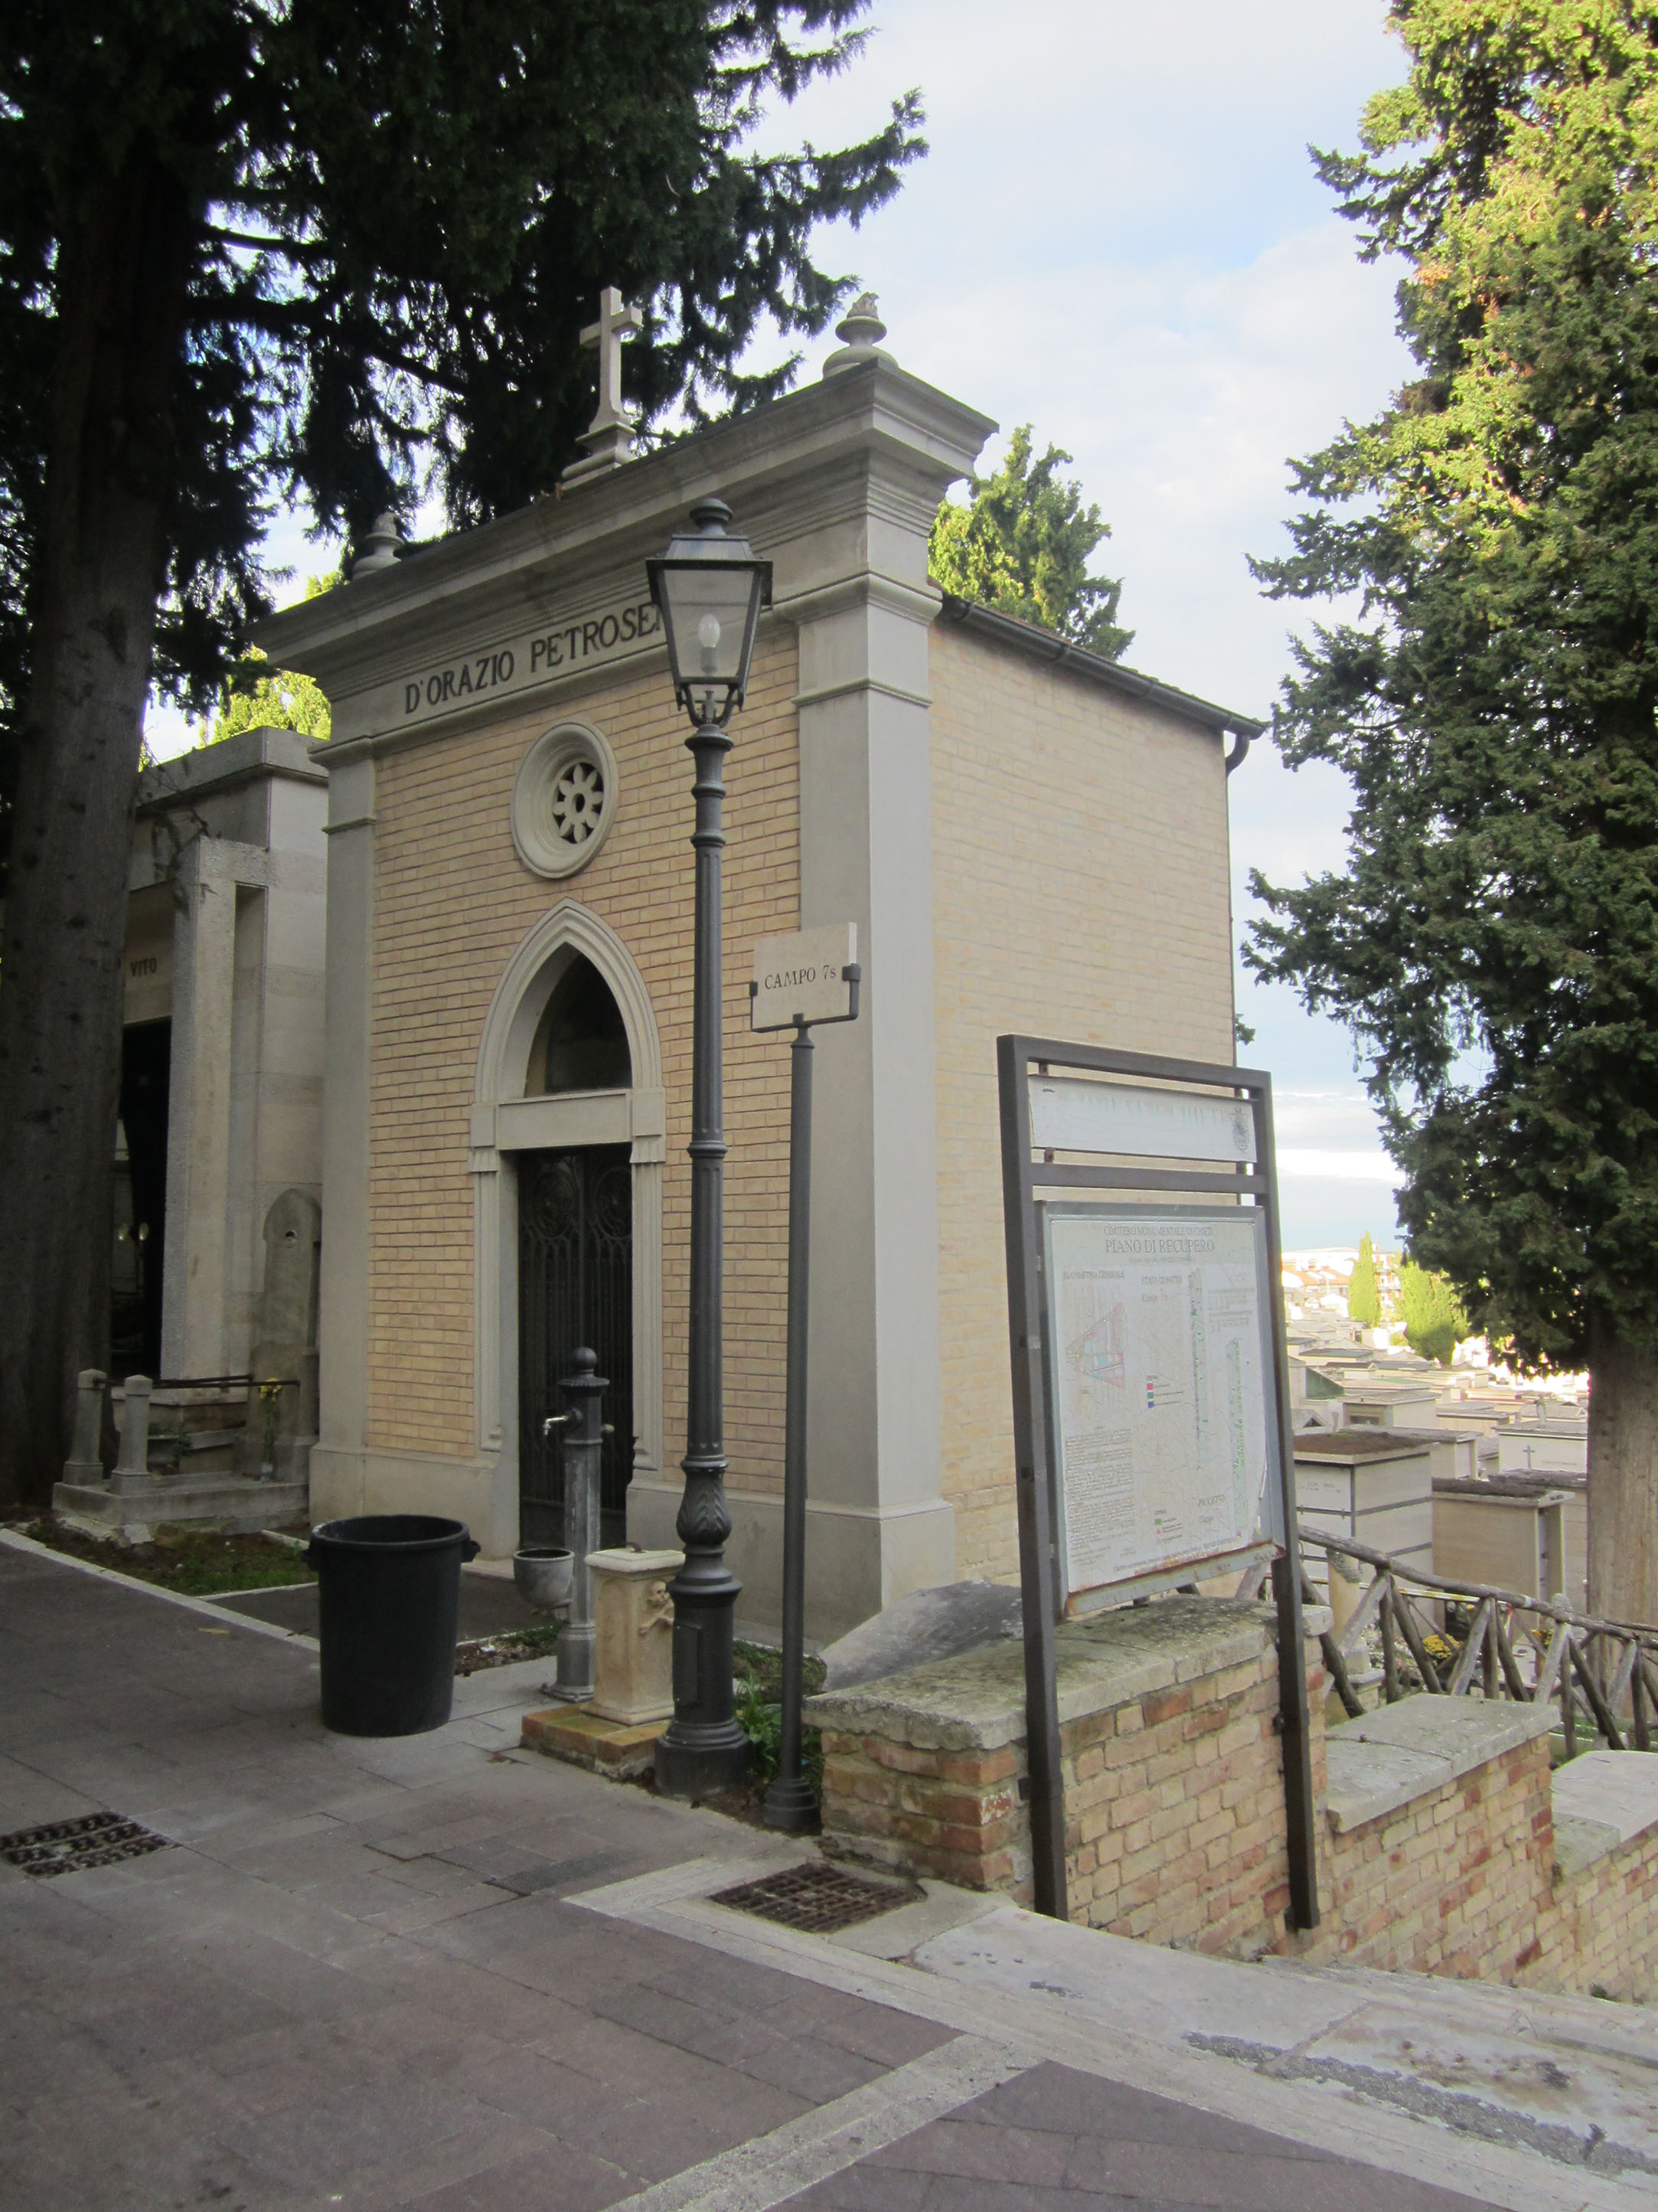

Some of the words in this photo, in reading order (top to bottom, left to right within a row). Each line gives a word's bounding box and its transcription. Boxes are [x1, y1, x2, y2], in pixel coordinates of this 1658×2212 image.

[404, 649, 515, 714] D'ORAZIO
[530, 602, 664, 672] PETROSE
[130, 957, 158, 977] VITO
[765, 966, 816, 990] CAMPO
[1105, 1239, 1142, 1254] PIANO
[1144, 1239, 1157, 1253] DI
[1159, 1238, 1216, 1253] RECUPERO
